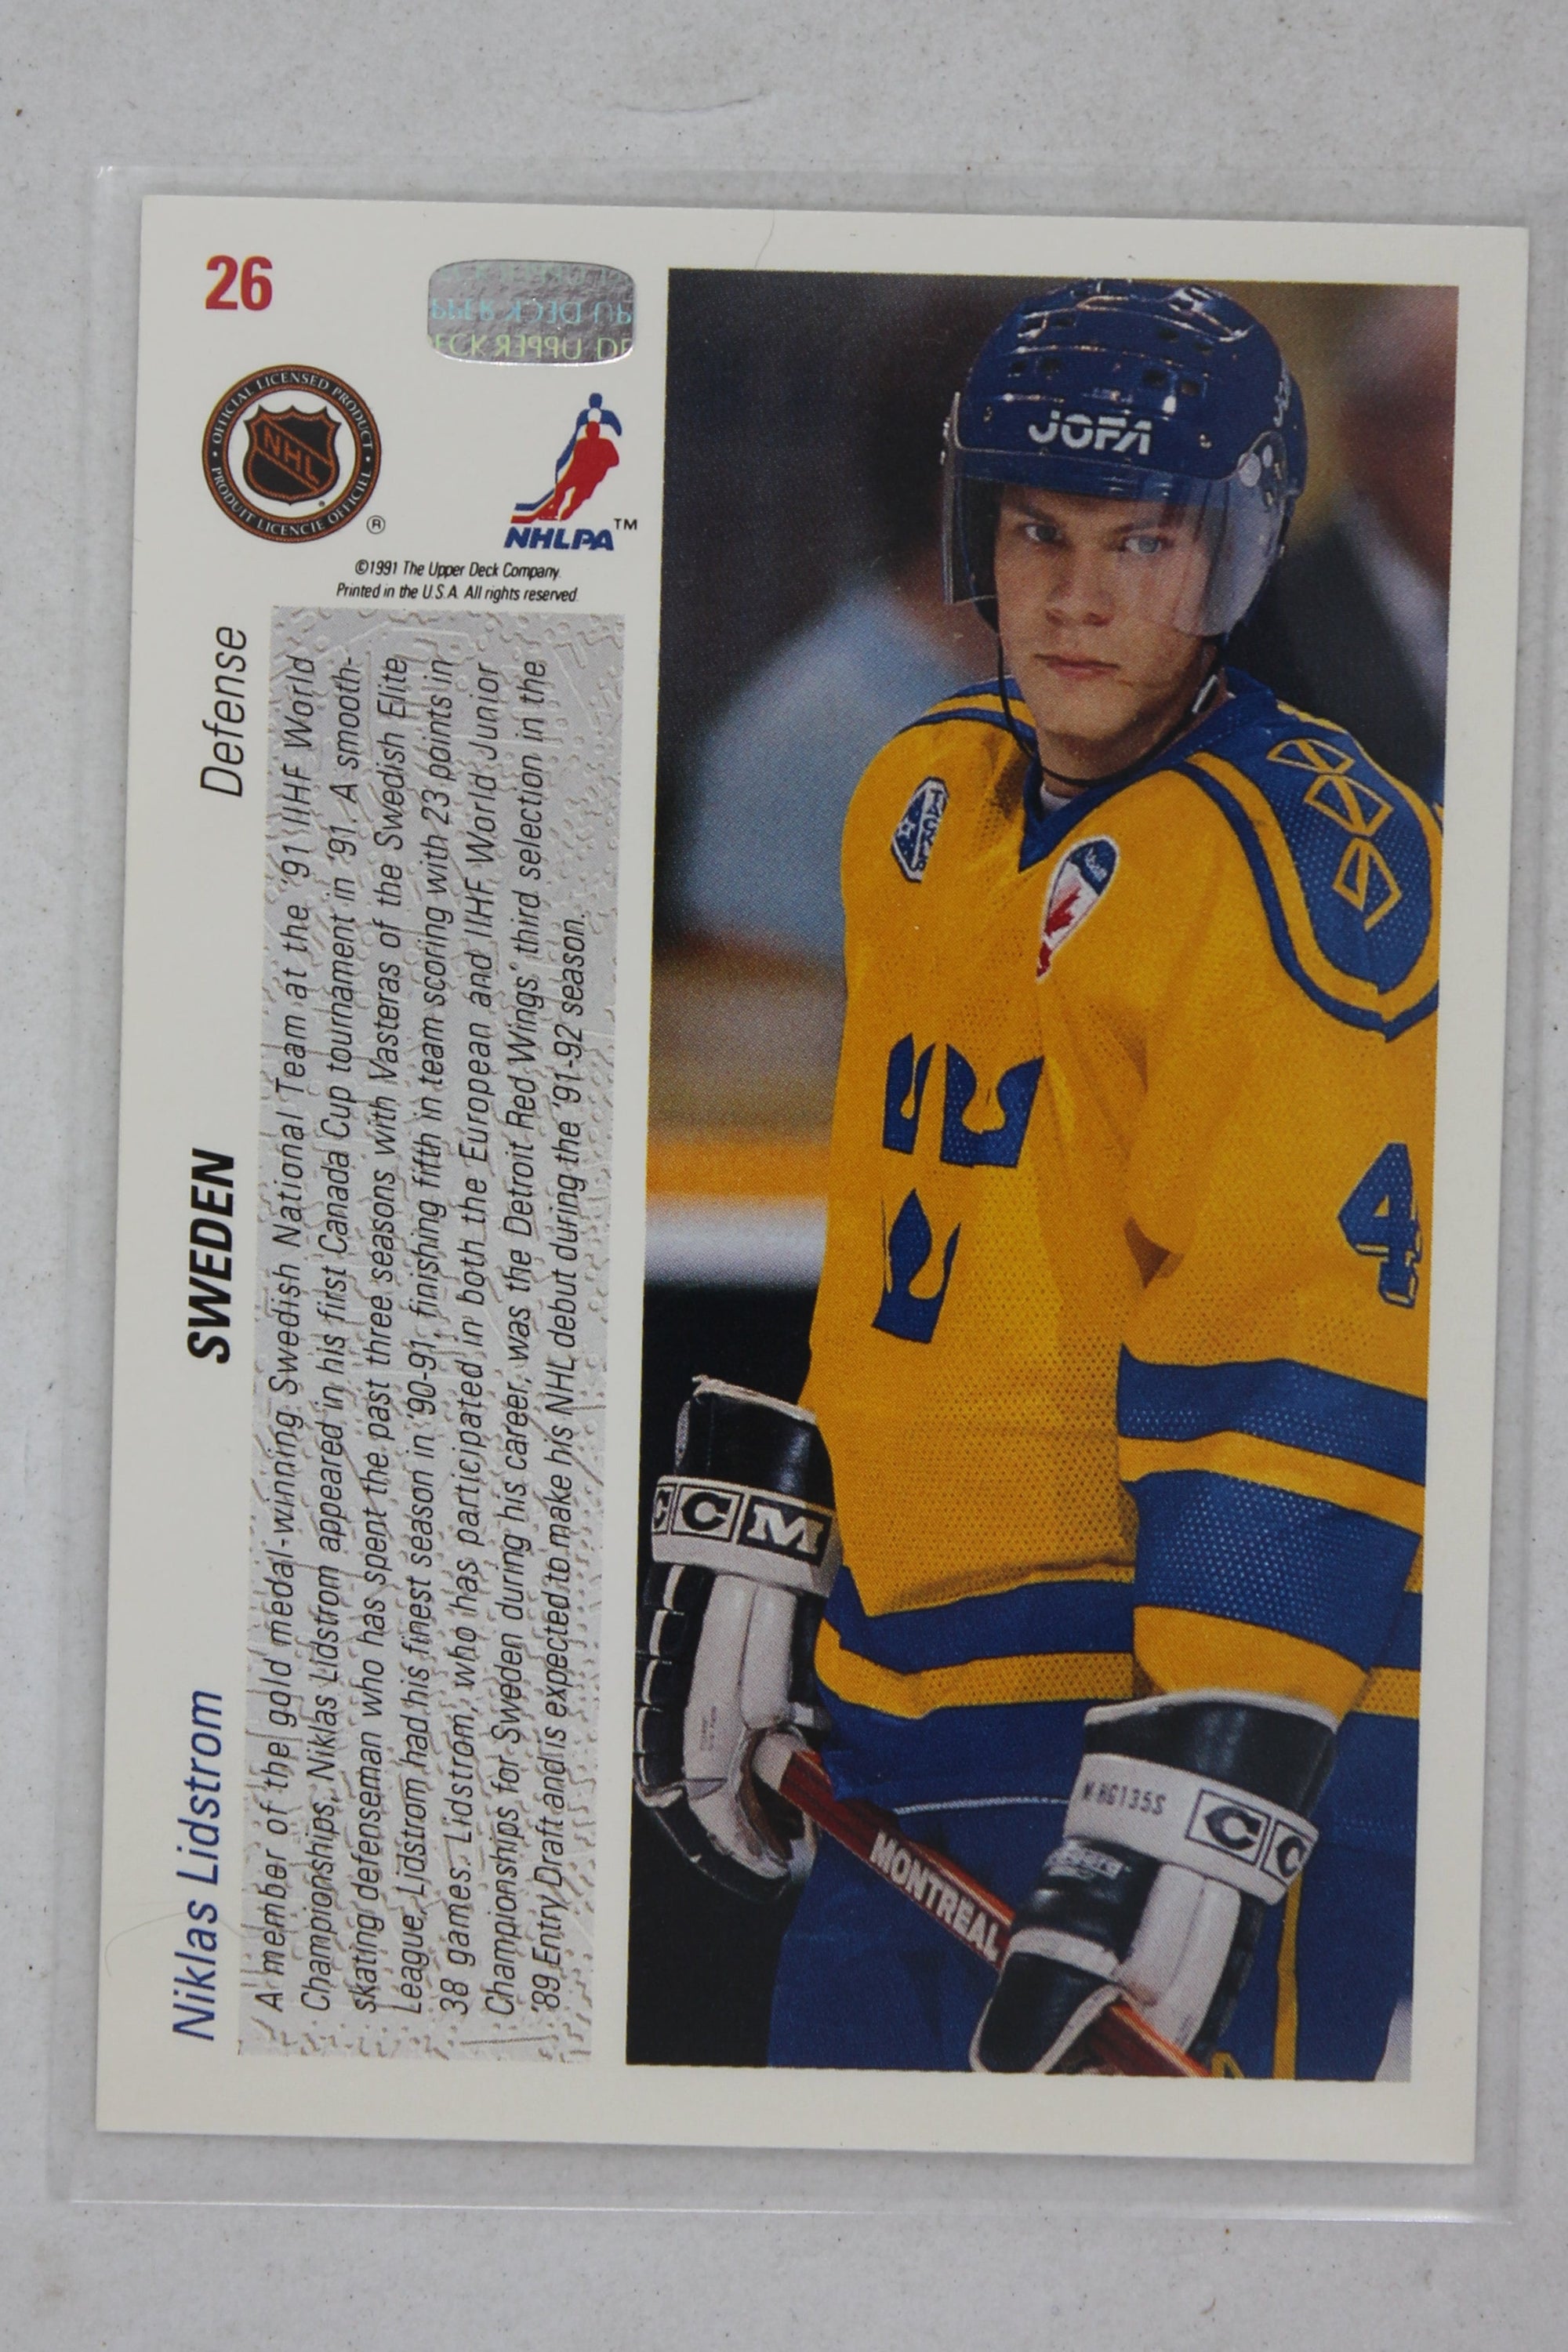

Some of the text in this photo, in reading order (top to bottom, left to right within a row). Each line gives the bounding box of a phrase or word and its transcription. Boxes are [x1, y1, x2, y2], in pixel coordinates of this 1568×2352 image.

[205, 255, 272, 311] 26
[212, 372, 374, 450] OFFICIAL LICENSED PRODUCT
[1028, 409, 1152, 456] JOFA
[263, 425, 320, 485] NHL
[211, 466, 372, 536] PRODUIT LICENCIE OFFICIEL
[355, 559, 562, 581] ©1991 The Upper Deck Company.
[503, 526, 615, 551] NHLPA
[336, 583, 381, 599] Printed
[383, 583, 395, 598] in
[399, 584, 417, 599] the
[464, 585, 481, 600] All
[485, 586, 520, 604] rights
[283, 655, 315, 748] World
[423, 659, 456, 684] in
[516, 661, 546, 705] the
[199, 626, 247, 797] Defense
[331, 656, 361, 770] smooth-
[422, 694, 457, 782] points
[515, 717, 545, 742] in
[281, 763, 311, 826] IIHF
[328, 783, 358, 804] A
[420, 789, 450, 826] 23
[512, 755, 543, 880] selection
[326, 877, 355, 902] in
[419, 834, 448, 895] with
[279, 905, 310, 953] the
[417, 906, 454, 1007] scoring
[510, 889, 541, 954] third
[282, 967, 310, 1000] at
[325, 913, 356, 1073] tournament
[561, 914, 586, 1017] season.
[275, 1014, 307, 1094] Team
[417, 1016, 445, 1085] team
[320, 1085, 358, 1141] Cup
[413, 1096, 442, 1122] in
[505, 1074, 536, 1131] Red
[411, 1133, 441, 1189] fifth
[550, 1120, 582, 1164] the
[271, 1111, 306, 1248] National
[318, 1150, 350, 1255] Canada
[503, 1140, 534, 1237] Detroit
[548, 1172, 589, 1261] during
[1337, 1141, 1423, 1309] 4
[187, 1147, 234, 1365] SWEDEN
[408, 1200, 448, 1318] finishing
[501, 1249, 532, 1293] the
[316, 1265, 347, 1322] first
[545, 1266, 579, 1348] debut
[268, 1264, 301, 1396] Swedish
[315, 1334, 347, 1375] his
[347, 658, 408, 2013] skating defenseman who has spent the past three seasons with Vasteras of the Swedish Elite
[439, 662, 499, 2016] 38 games. Lidstrom, who has participated in both the European and IIHF World Junior
[507, 1305, 531, 1361] was
[314, 1385, 345, 1410] in
[544, 1356, 577, 1416] NHL
[405, 1435, 435, 1459] in
[495, 1376, 536, 1471] career,
[543, 1425, 574, 1466] his
[314, 1421, 352, 1552] appeared
[408, 1470, 434, 1567] season
[495, 1481, 527, 1523] his
[543, 1474, 572, 1548] make
[263, 1410, 304, 1646] medal-winning
[494, 1534, 532, 1621] during
[544, 1557, 571, 1583] to
[308, 1565, 340, 1683] Lidstrom
[401, 1575, 433, 1655] finest
[400, 1665, 430, 1707] his
[489, 1632, 526, 1744] Sweden
[540, 1590, 574, 1718] expected
[260, 1657, 299, 1728] gold
[260, 1740, 290, 1788] the
[306, 1694, 338, 1781] Niklas
[398, 1714, 430, 1768] had
[536, 1726, 567, 1749] is
[490, 1754, 520, 1794] for
[536, 1756, 567, 1809] and
[259, 1802, 289, 1835] of
[394, 1777, 428, 1897] Lidstrom
[533, 1816, 564, 1888] Draft
[172, 1690, 223, 2042] Niklas Lidstrom
[869, 1828, 1000, 1962] MONTREAL
[257, 1848, 288, 1976] member
[300, 1796, 340, 2011] Championships,
[485, 1806, 525, 2016] Championships
[532, 1894, 568, 1966] Entry
[390, 1907, 430, 2014] League,
[254, 1992, 283, 2013] A
